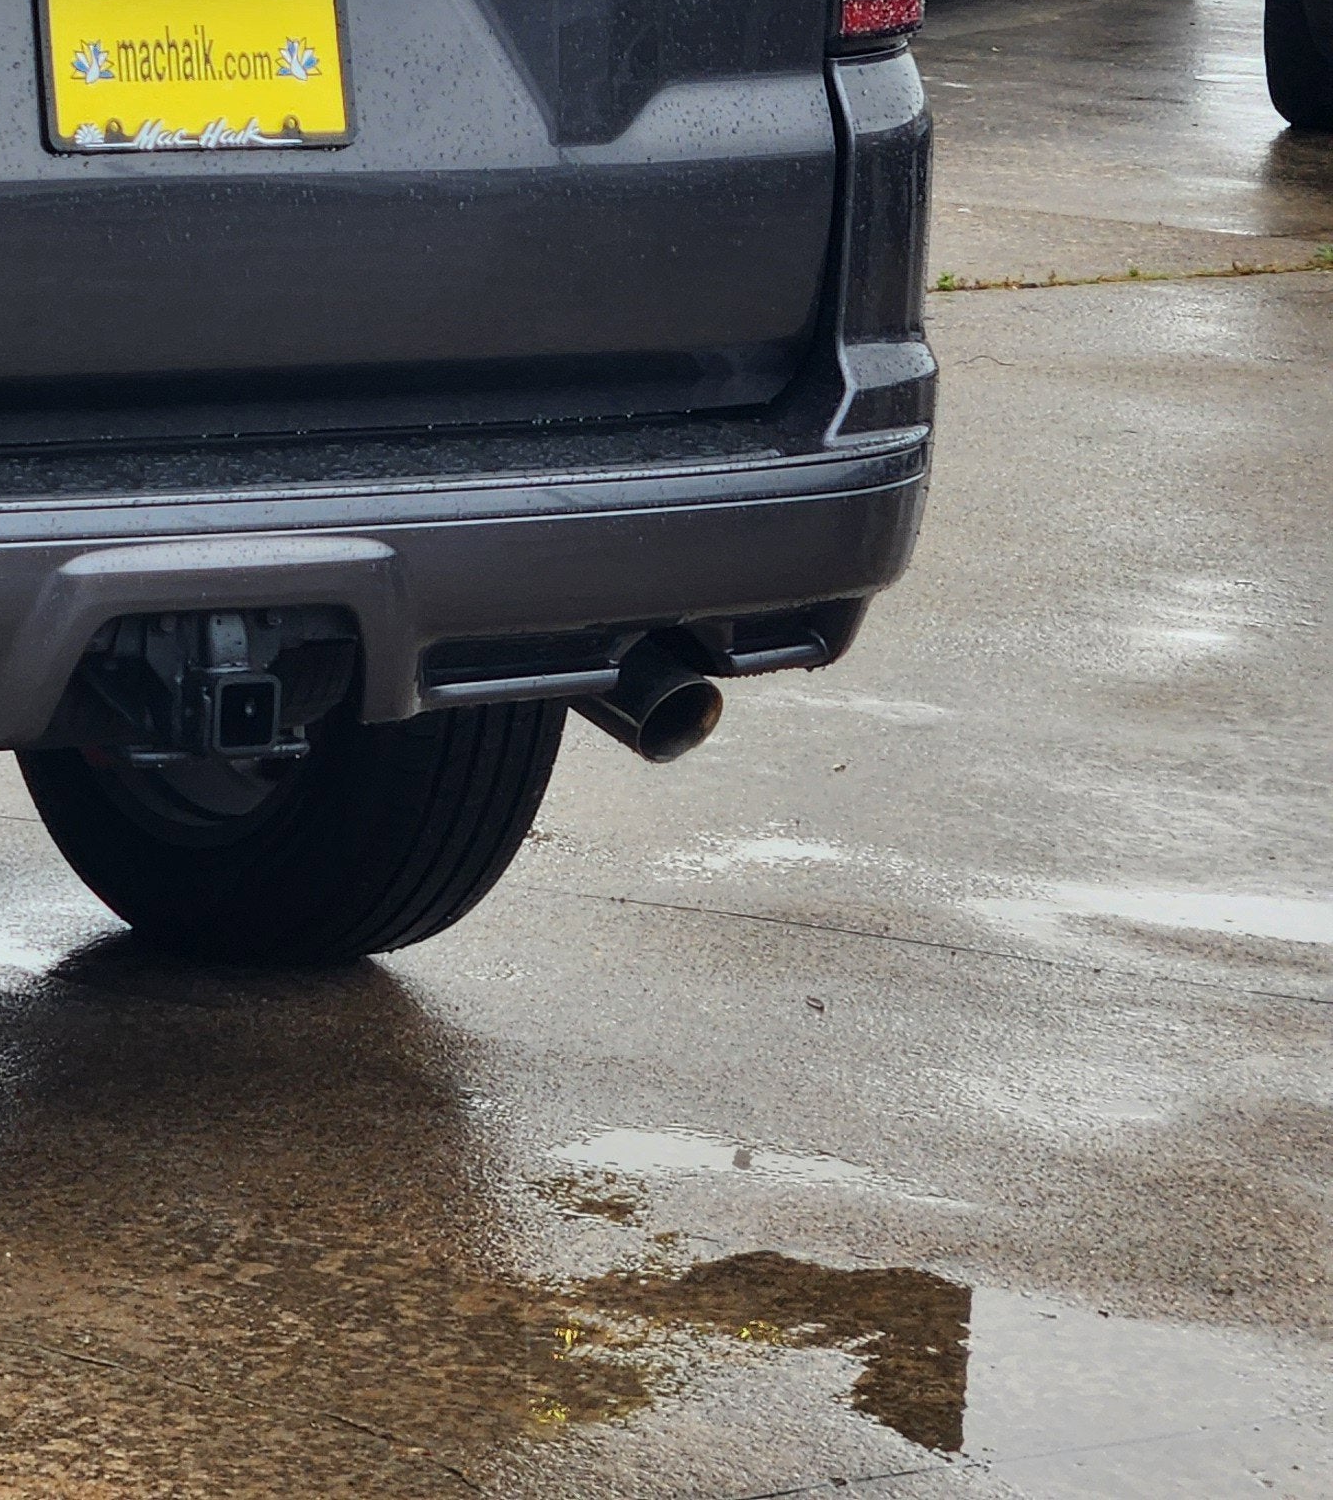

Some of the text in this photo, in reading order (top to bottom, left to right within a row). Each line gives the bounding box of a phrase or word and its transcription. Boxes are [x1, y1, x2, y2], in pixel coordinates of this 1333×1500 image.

[116, 24, 274, 83] machaik.com
[119, 116, 285, 150] Mac Haik
